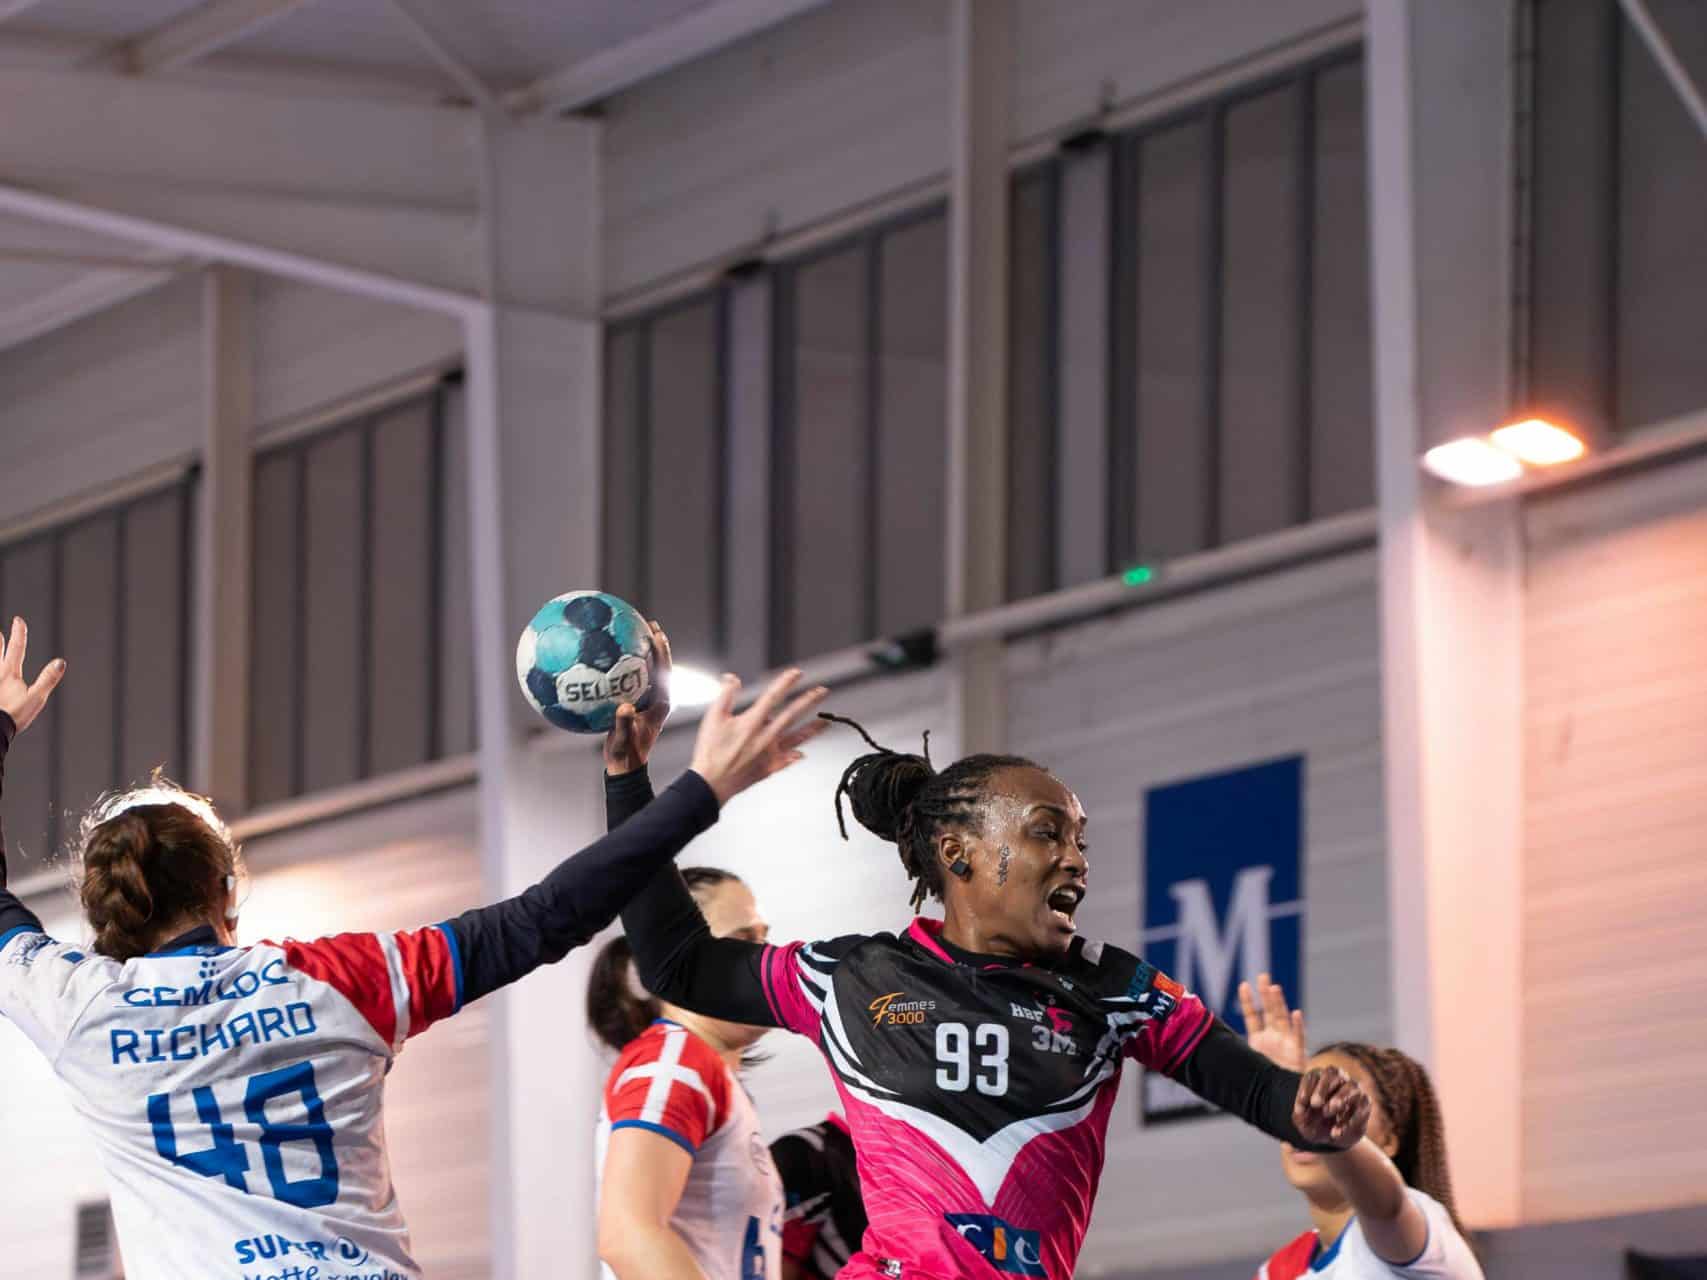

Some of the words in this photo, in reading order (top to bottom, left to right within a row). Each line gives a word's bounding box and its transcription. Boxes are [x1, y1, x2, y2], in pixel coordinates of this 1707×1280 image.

[565, 669, 643, 702] SELECT
[1169, 865, 1276, 1018] M
[110, 1001, 317, 1065] RICHARD
[868, 991, 936, 1030] Femmes
[887, 1010, 925, 1026] 3000
[935, 1021, 1010, 1097] 93
[1031, 1024, 1077, 1056] 3M
[146, 1060, 339, 1209] 48
